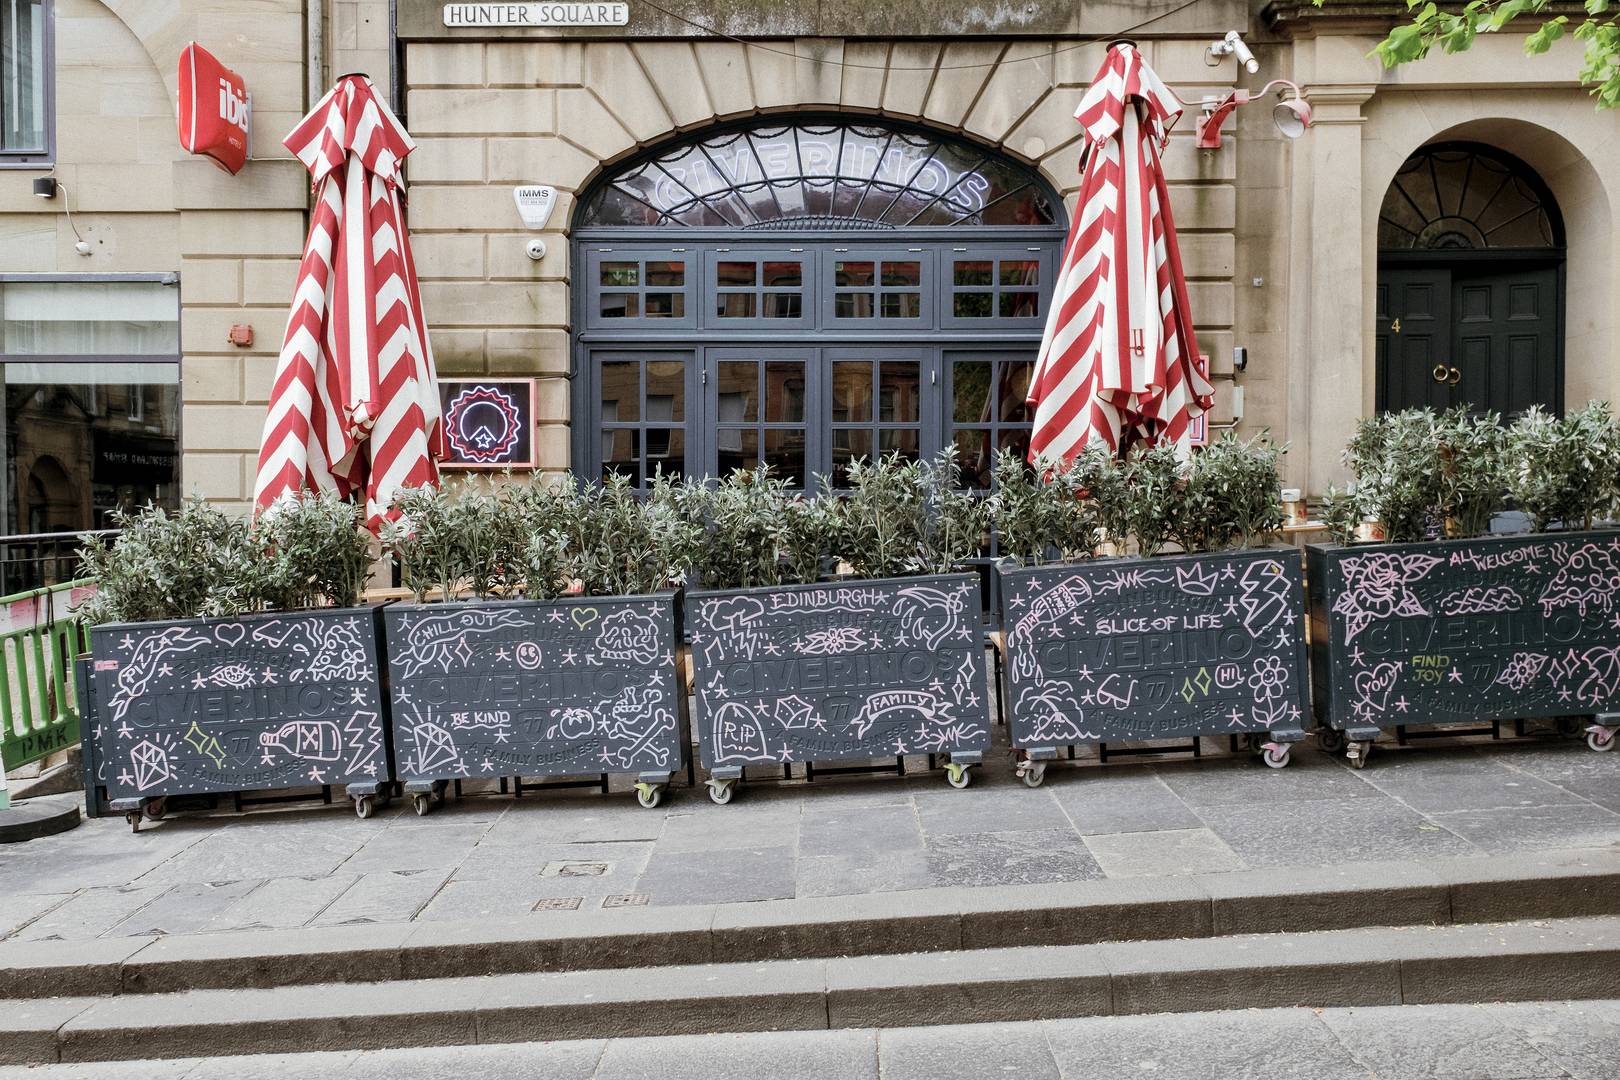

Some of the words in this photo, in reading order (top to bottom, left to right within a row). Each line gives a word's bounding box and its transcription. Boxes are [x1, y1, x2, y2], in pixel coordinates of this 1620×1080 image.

[450, 6, 529, 23] HUNTER
[540, 5, 624, 23] SQUARE
[654, 141, 989, 215] CIVERINOS
[519, 189, 549, 197] IMMS
[1391, 317, 1401, 332] 4
[1449, 549, 1482, 567] ALL
[1473, 543, 1549, 571] WELCOME
[769, 588, 877, 609] EDINBURGH
[414, 621, 460, 647] CHILL
[460, 614, 498, 626] OUT
[1095, 616, 1150, 635] SLICE
[1150, 616, 1178, 631] OF
[1183, 614, 1225, 630] LIFE
[122, 635, 174, 684] PIZZA
[1411, 655, 1450, 668] FIND
[725, 648, 956, 695] CIVERINOS
[1220, 668, 1238, 681] HI
[1411, 670, 1444, 685] JOY
[1472, 664, 1492, 680] 77
[1146, 681, 1166, 698] 77
[1361, 673, 1389, 698] YOU
[871, 692, 929, 712] FAMILY
[451, 712, 474, 727] BE
[477, 711, 511, 724] KIND
[831, 703, 851, 721] 77
[523, 717, 543, 734] 77
[723, 721, 756, 745] RIP
[22, 726, 68, 759] PMK
[231, 737, 251, 753] 77
